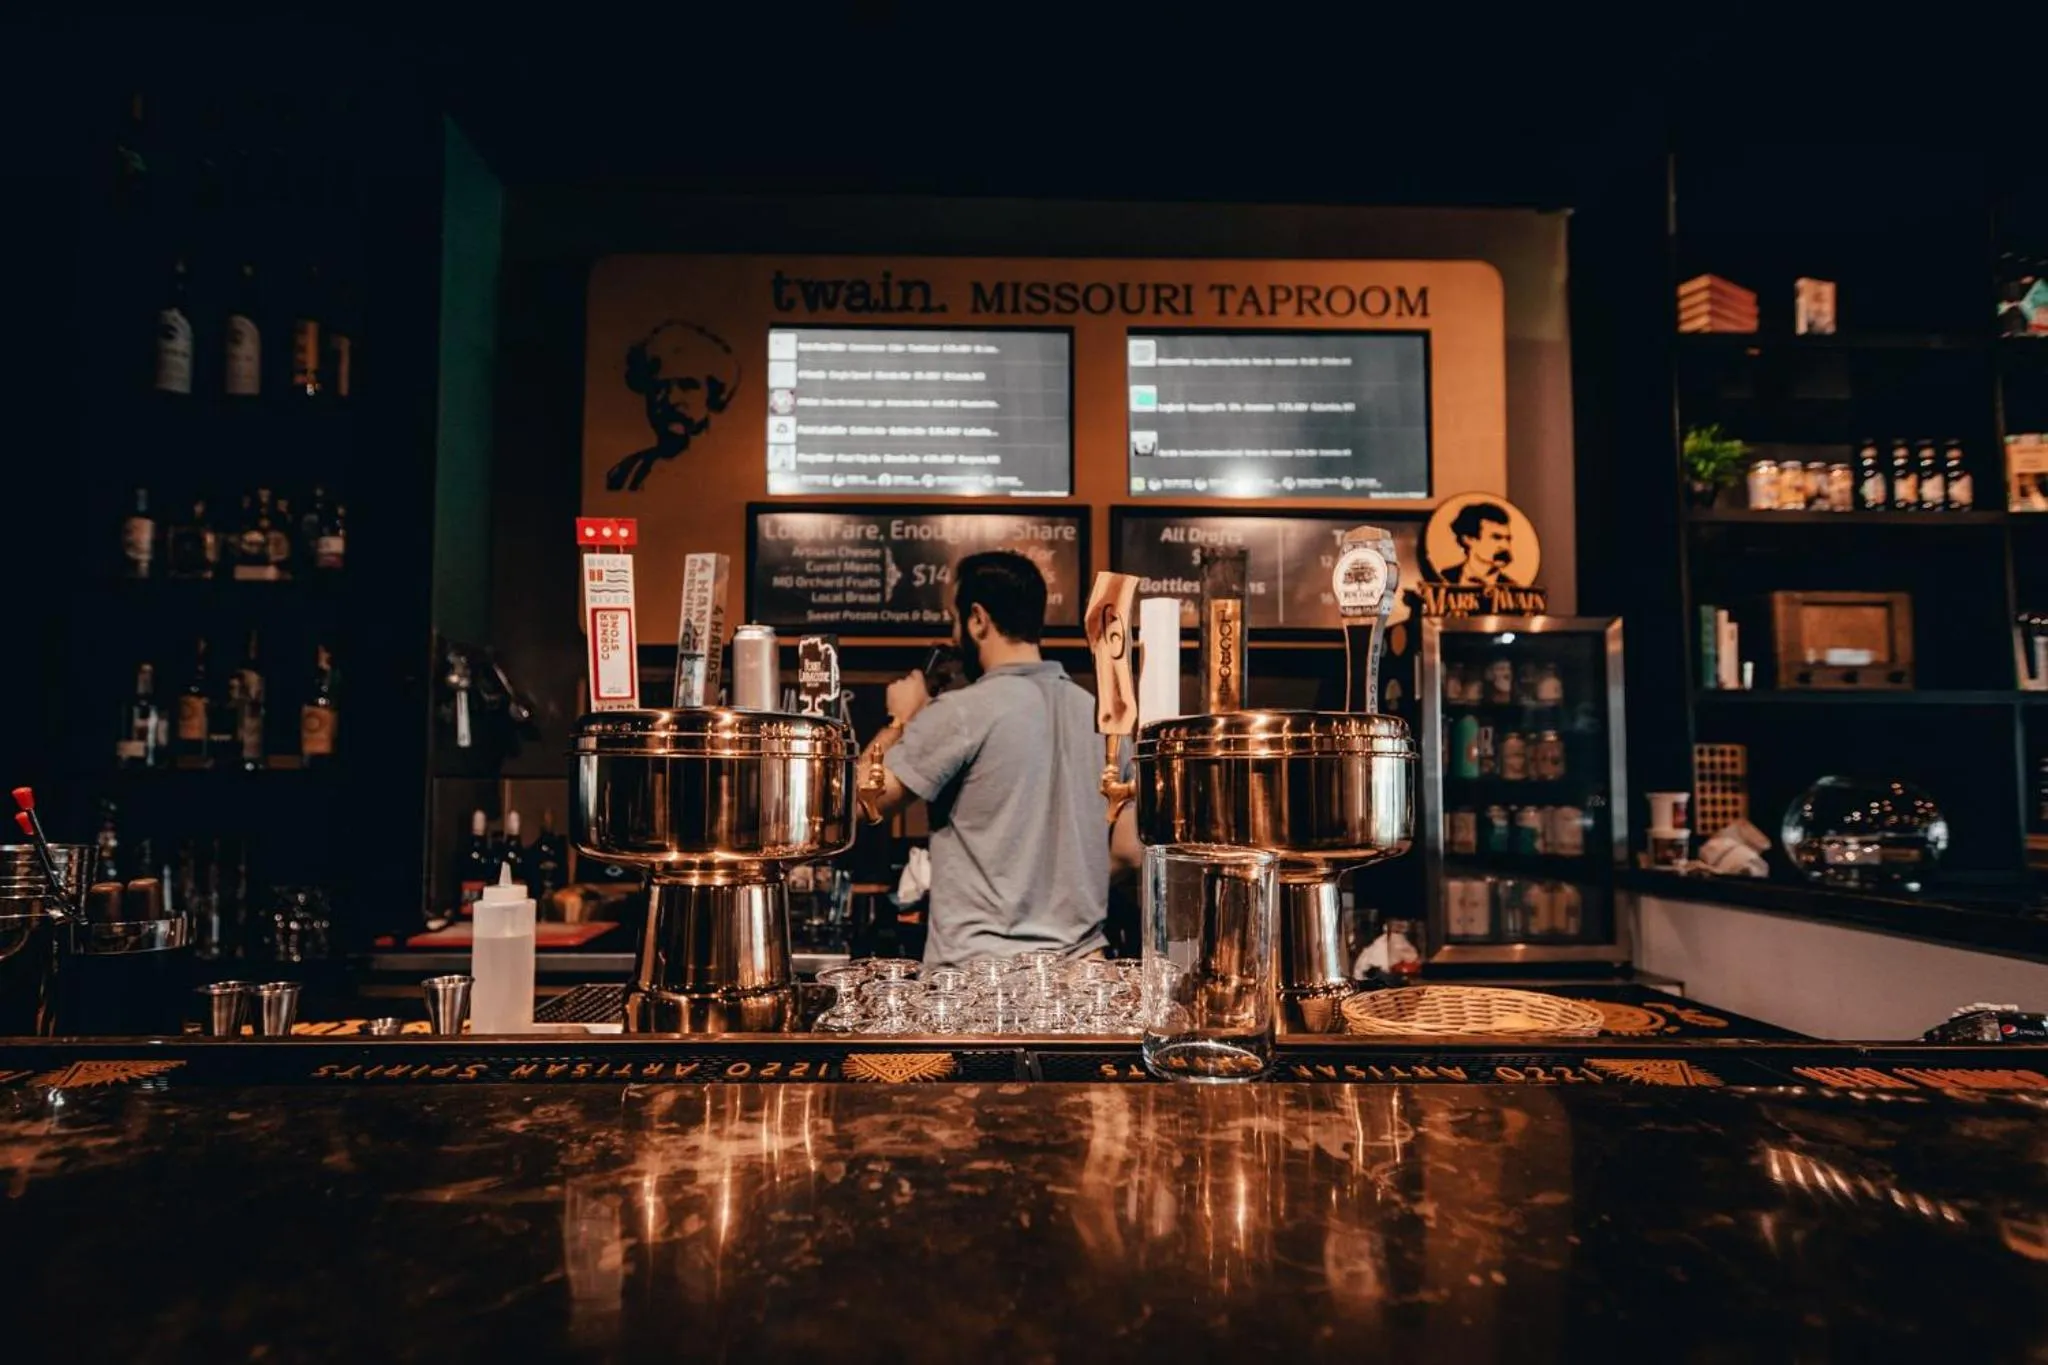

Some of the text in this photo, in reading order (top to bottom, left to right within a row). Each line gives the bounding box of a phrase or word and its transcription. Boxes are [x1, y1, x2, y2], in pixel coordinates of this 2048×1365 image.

[970, 280, 1194, 316] MISSOURI
[1209, 282, 1431, 318] TAPROOM
[829, 519, 885, 543] Fare,
[1013, 519, 1078, 542] Share
[1160, 526, 1185, 543] All
[1139, 577, 1201, 594] Bottles
[600, 613, 610, 661] CORNER
[610, 613, 620, 651] STONE
[707, 620, 723, 686] HANDS
[1218, 608, 1233, 706] LOGBOA
[310, 1063, 489, 1080] SPIRITS
[511, 1063, 698, 1079] ARTISAN
